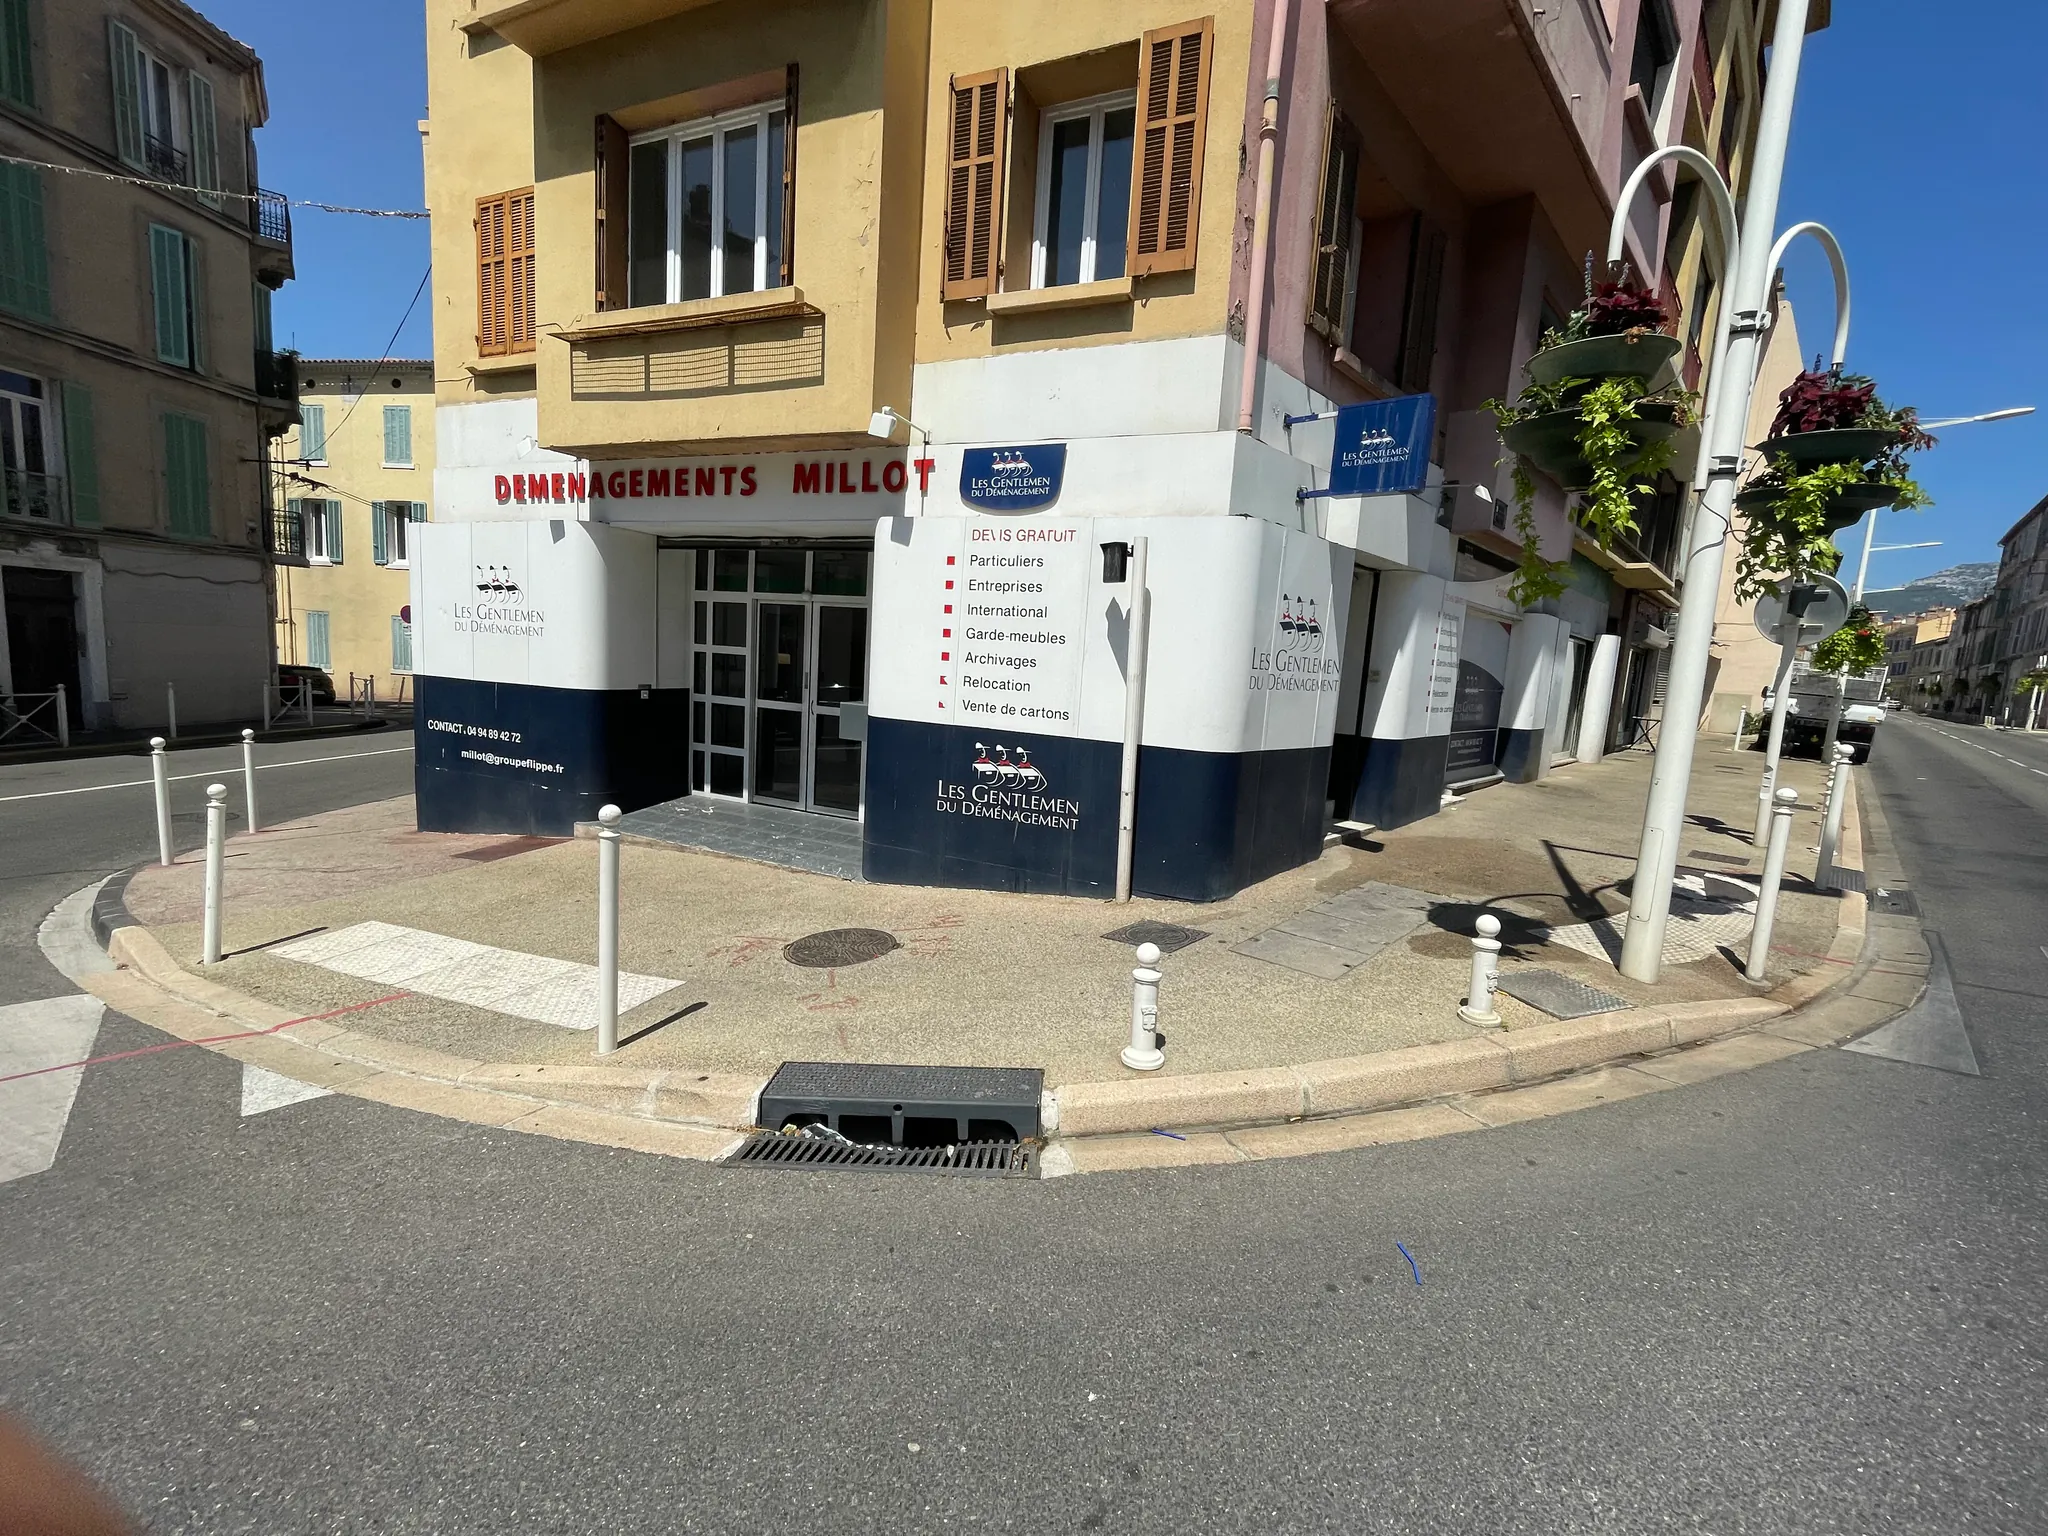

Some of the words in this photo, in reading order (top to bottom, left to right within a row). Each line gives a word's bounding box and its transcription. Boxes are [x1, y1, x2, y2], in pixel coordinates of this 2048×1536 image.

[1343, 451, 1357, 461] LES
[1359, 447, 1410, 458] GENTLEMEN
[494, 466, 758, 503] DEMENAGEMENTS
[792, 458, 936, 494] MILLOT
[972, 478, 988, 489] LES
[991, 476, 1050, 488] GENTLEMEN
[971, 489, 984, 497] DU
[1016, 529, 1077, 542] GRATUIT
[970, 555, 1044, 567] Particuliers
[968, 579, 1043, 595] Entreprises
[453, 602, 472, 619] LES
[476, 603, 545, 623] GENTLEMEN
[967, 604, 1048, 618] International
[454, 621, 468, 632] DU
[470, 620, 545, 637] DÉMÉNAGEMENT
[965, 627, 1067, 645] Garde-meubles
[964, 651, 1038, 670] Archivages
[1251, 647, 1272, 671] LES
[963, 675, 1031, 692] Relocation
[1249, 675, 1264, 690] DU
[962, 699, 997, 714] Vente
[1000, 703, 1017, 716] de
[1020, 707, 1070, 721] cartons
[467, 725, 477, 736] 04
[477, 727, 487, 739] 94
[488, 729, 499, 740] 89
[499, 731, 510, 742] 42
[511, 732, 521, 743] 72
[461, 749, 564, 774] millot@groupeflippe.fr
[938, 779, 965, 800] LES
[971, 784, 1080, 815] GENTLEMEN
[936, 800, 957, 813] DU
[962, 801, 1079, 831] DÉMÉNAGEMENT
